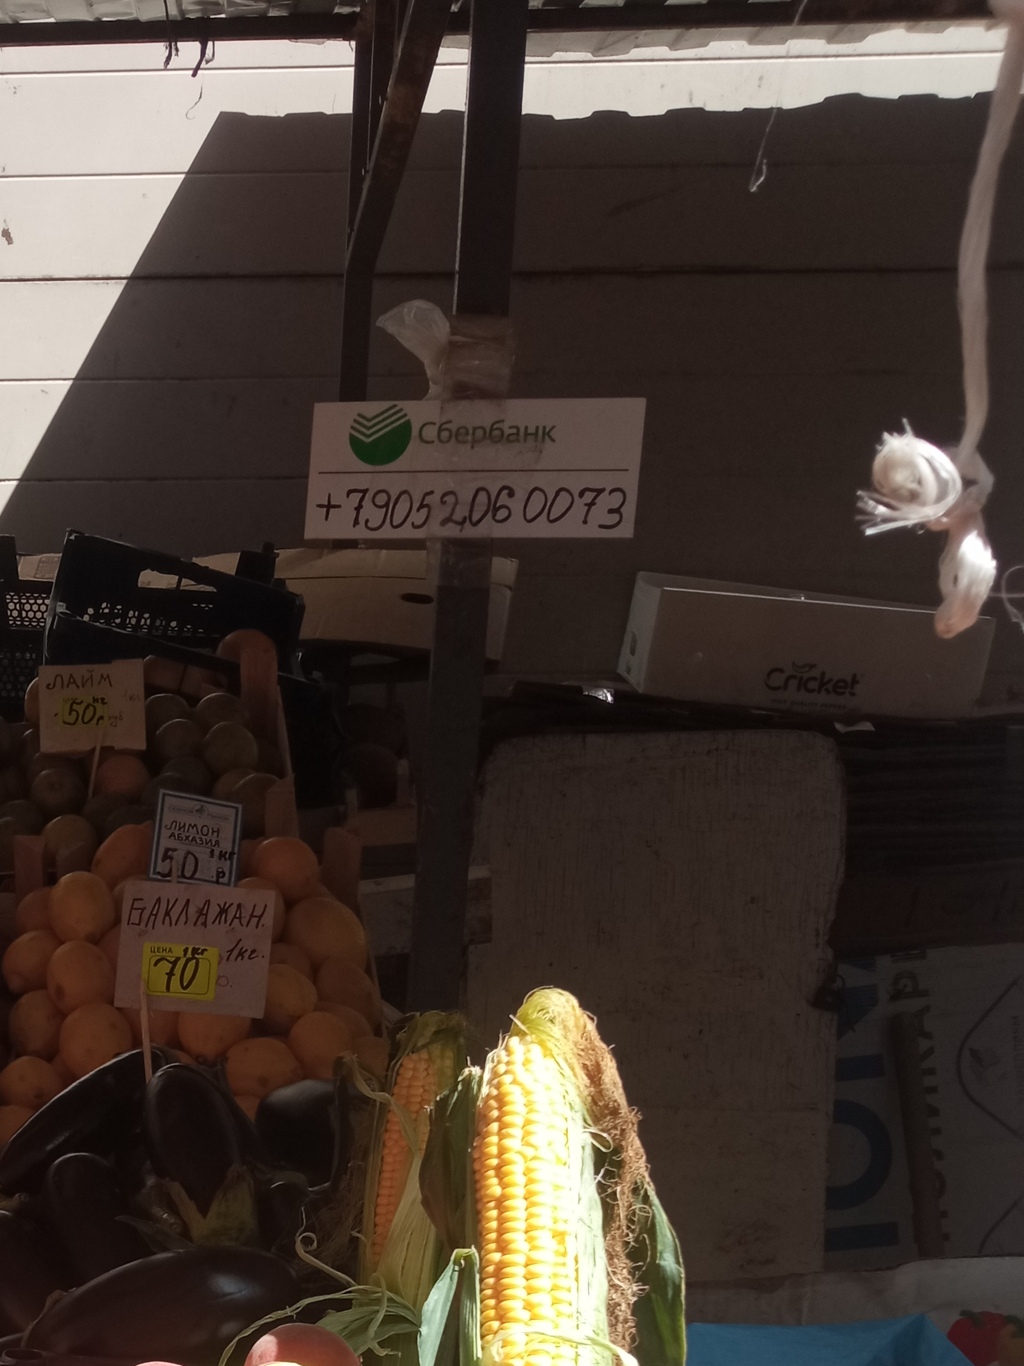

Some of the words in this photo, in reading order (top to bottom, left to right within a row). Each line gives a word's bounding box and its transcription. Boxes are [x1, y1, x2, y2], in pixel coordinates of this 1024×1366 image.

[418, 419, 557, 450] Сбербанк
[46, 669, 112, 690] ЛАЙМ
[764, 667, 860, 697] Cricket
[164, 820, 220, 838] ЛИМОН
[168, 831, 220, 848] АБХАЗИЯ
[156, 847, 199, 880] 50
[150, 946, 173, 954] ЦЕНА
[153, 956, 200, 993] 70
